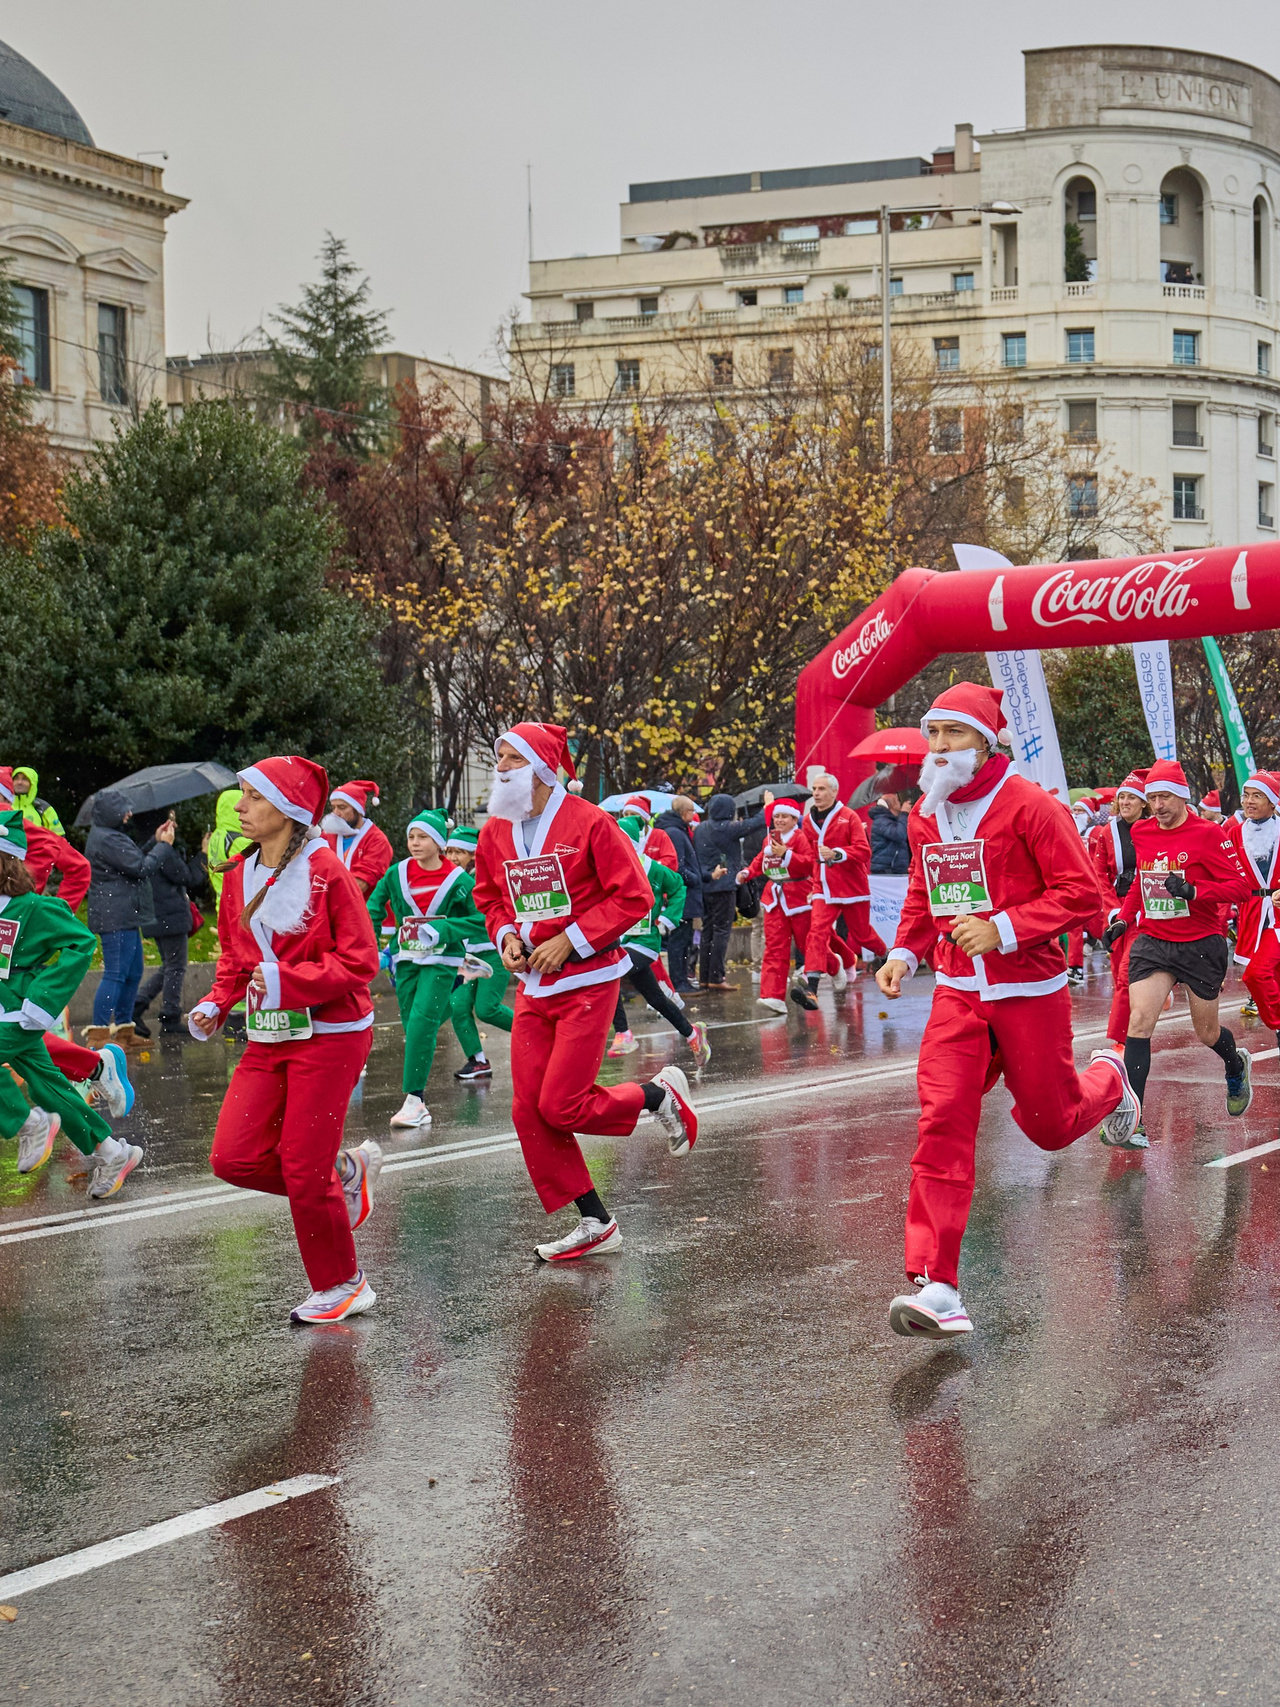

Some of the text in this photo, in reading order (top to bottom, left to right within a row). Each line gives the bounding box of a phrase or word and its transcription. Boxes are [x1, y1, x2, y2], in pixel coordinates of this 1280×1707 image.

[1031, 557, 1206, 627] Coca-Cola
[832, 609, 894, 679] Coca-Cola
[942, 852, 959, 863] Papá
[523, 864, 556, 877] Papá Noel
[521, 892, 551, 911] 9407
[939, 883, 972, 903] 6462
[1149, 899, 1175, 911] 2778
[255, 1011, 291, 1031] 9409
